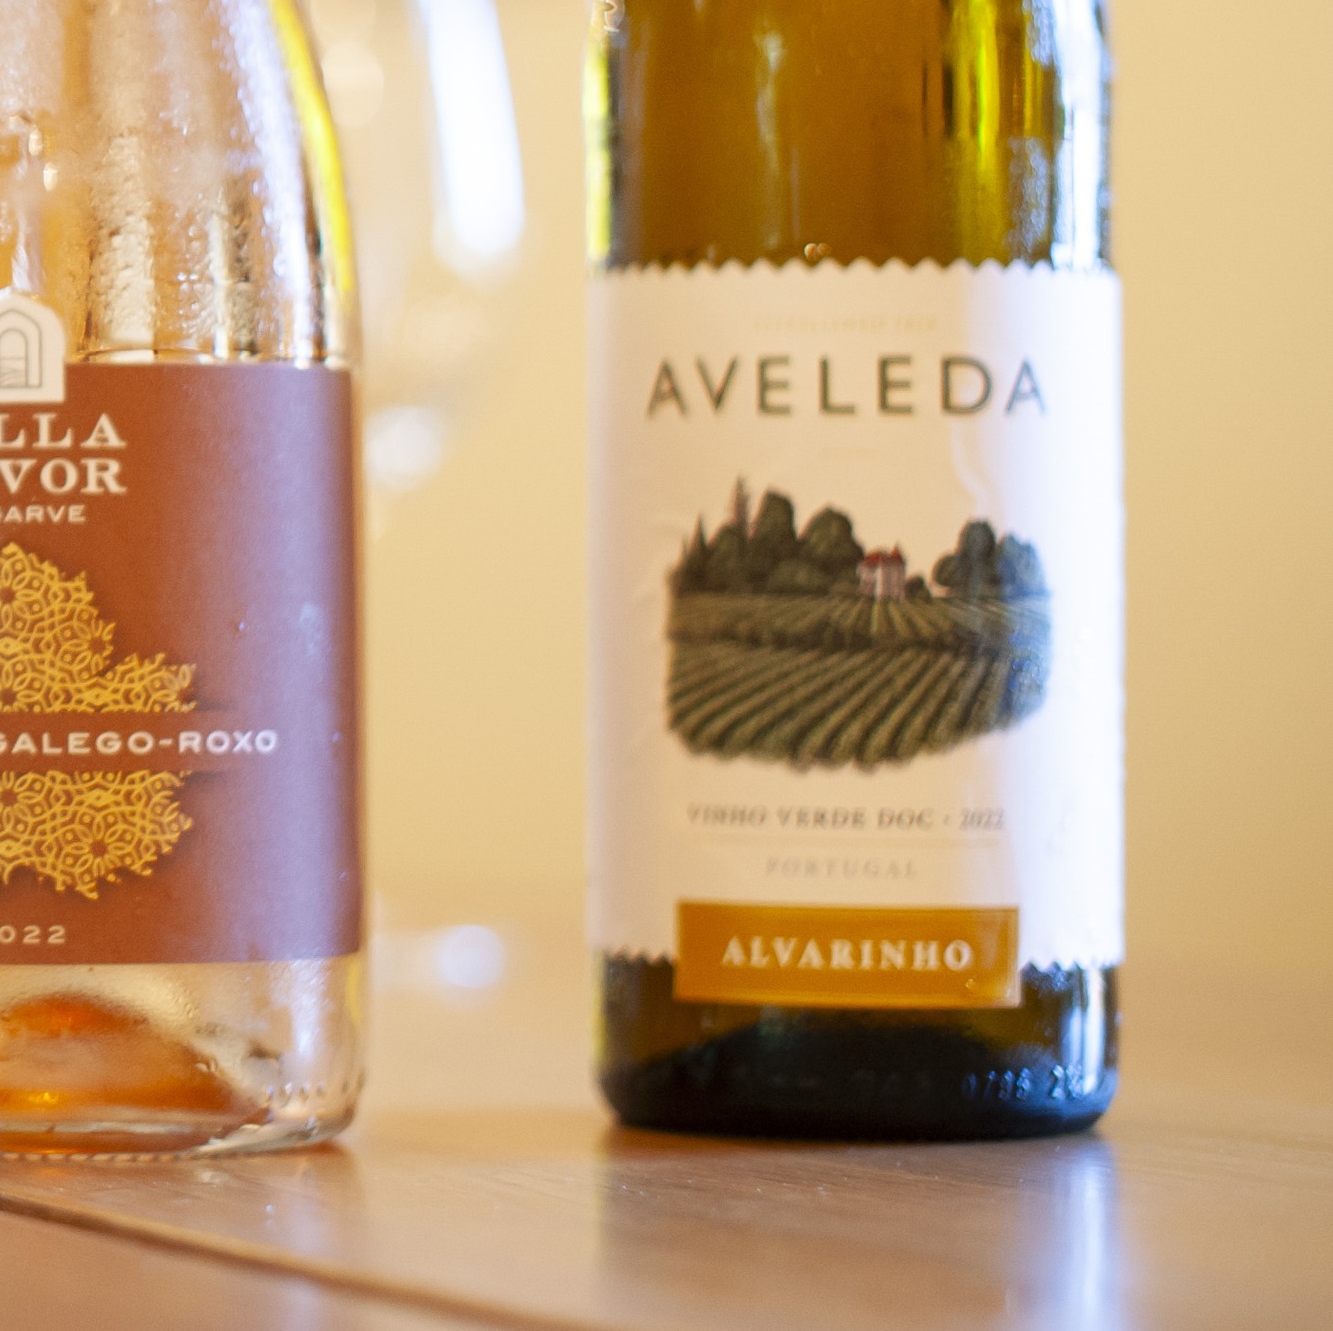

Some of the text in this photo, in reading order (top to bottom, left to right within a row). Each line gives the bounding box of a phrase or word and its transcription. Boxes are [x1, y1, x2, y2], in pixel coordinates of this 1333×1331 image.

[646, 354, 1048, 418] AVELEDA
[687, 803, 767, 828] VINHO
[776, 807, 867, 830] VERDE
[878, 807, 933, 831] DOC
[765, 856, 915, 879] PORTUGAL
[721, 935, 973, 971] ALVARINHO
